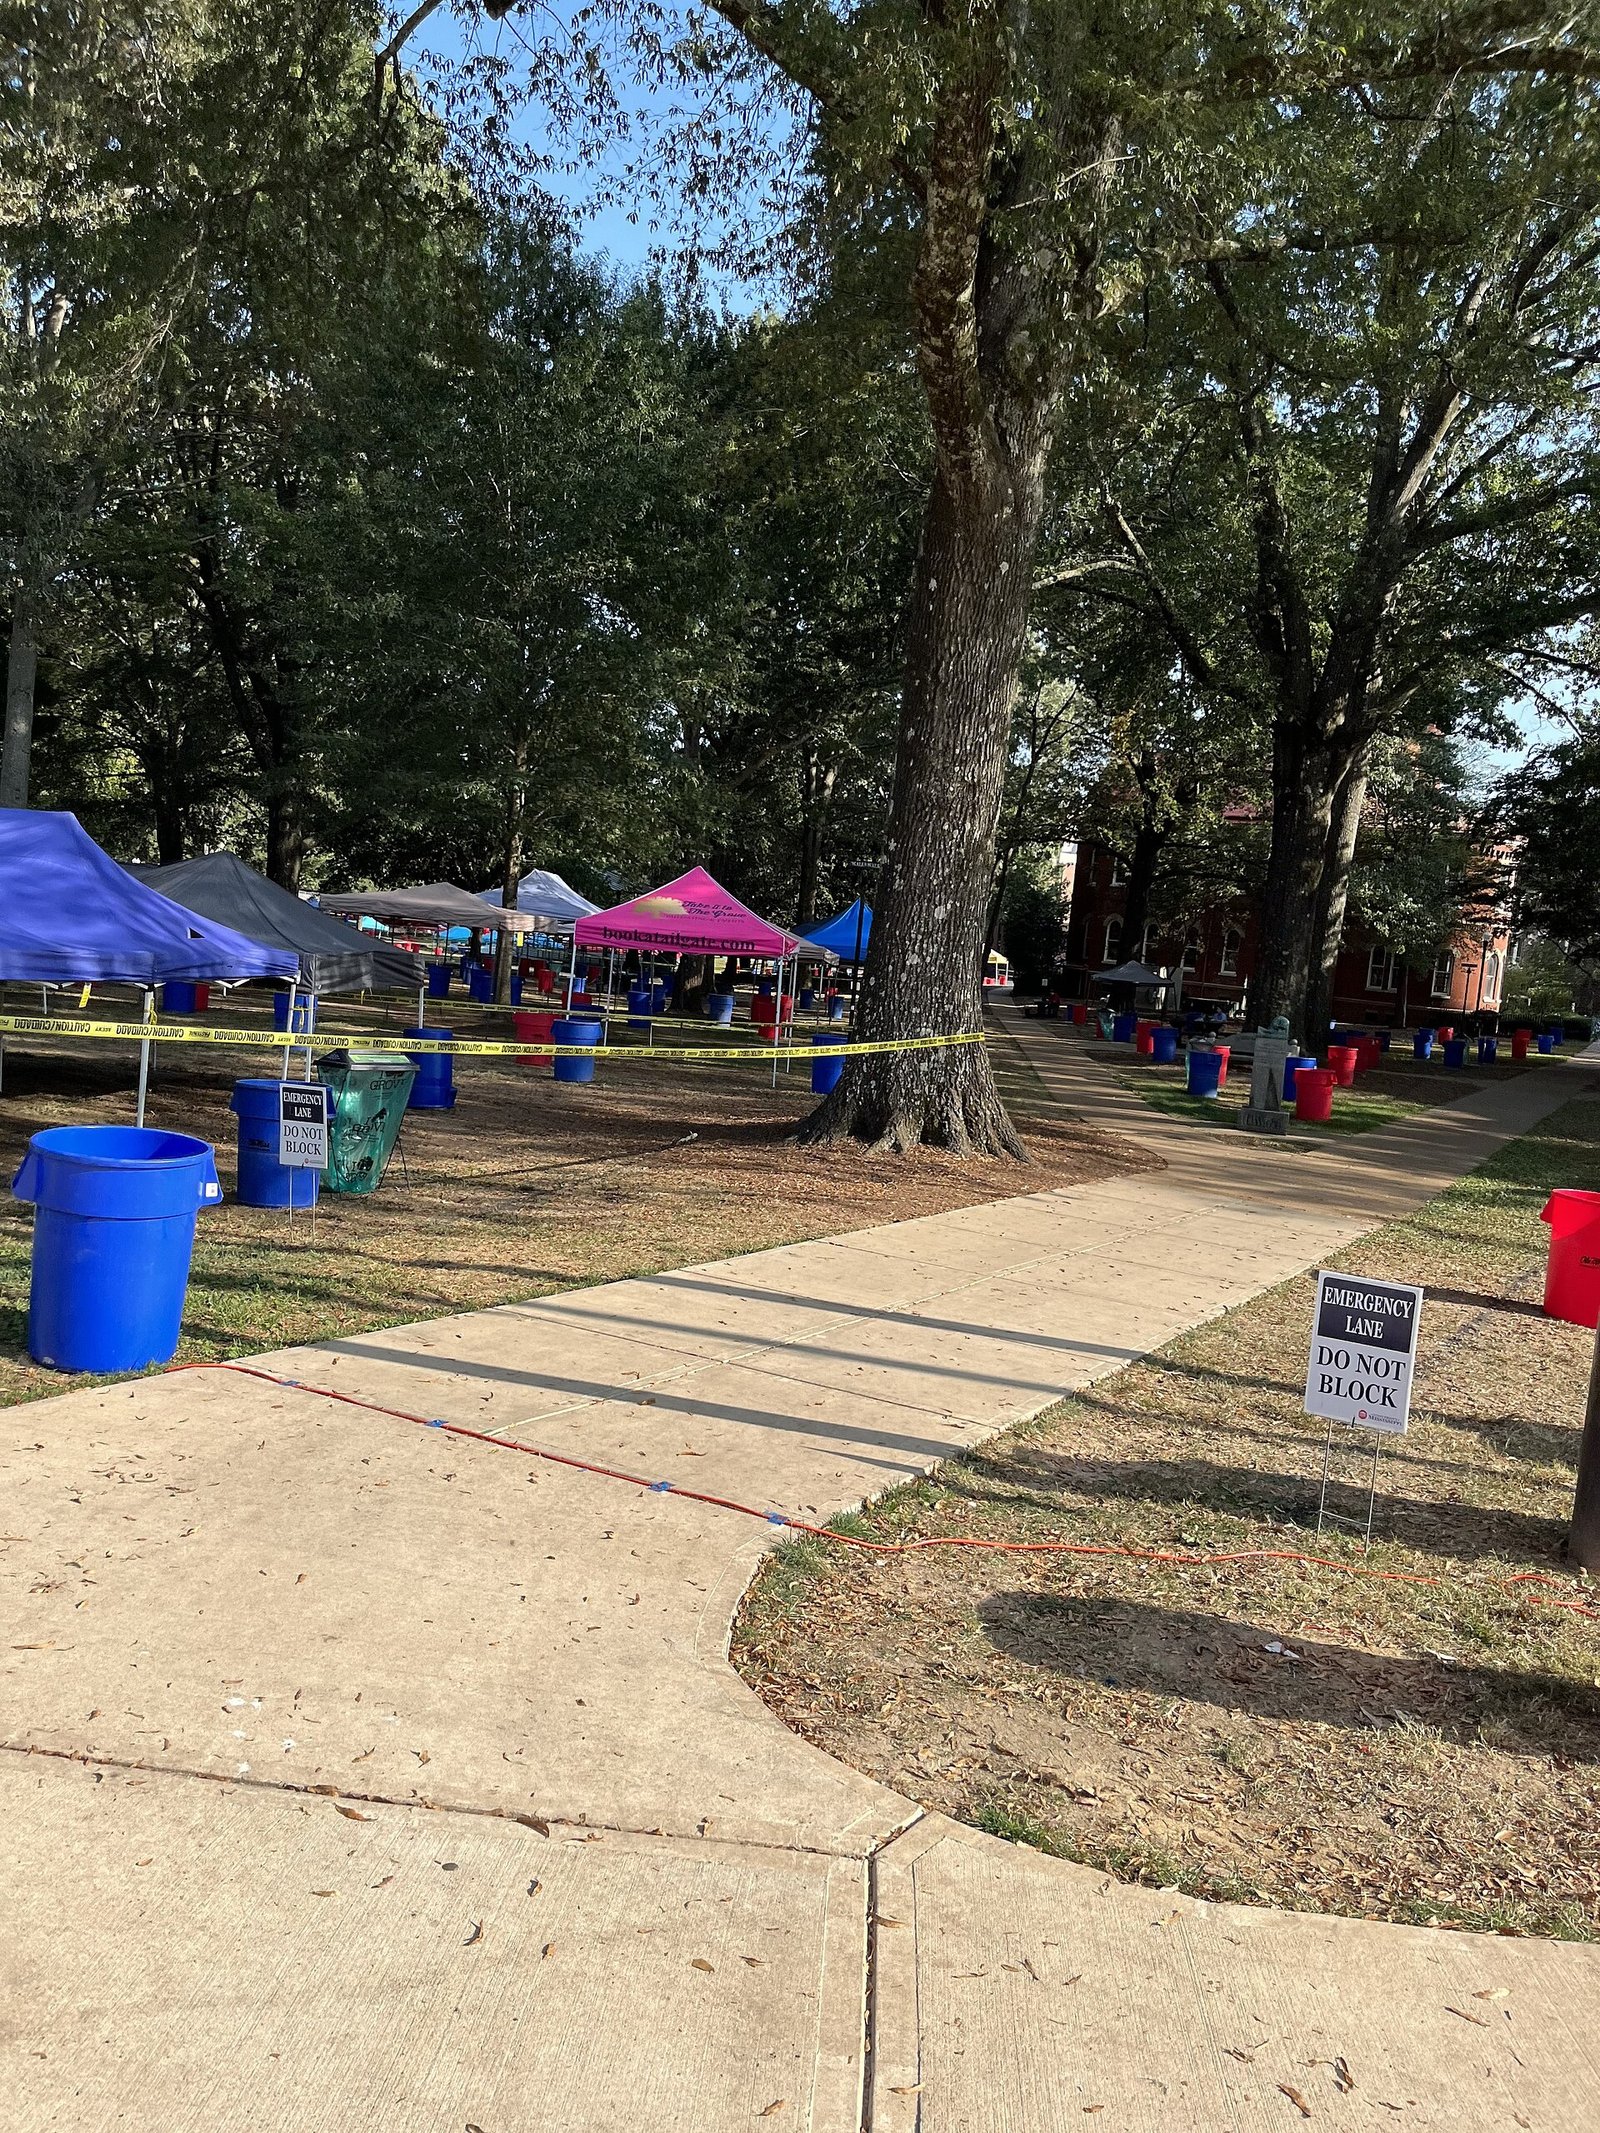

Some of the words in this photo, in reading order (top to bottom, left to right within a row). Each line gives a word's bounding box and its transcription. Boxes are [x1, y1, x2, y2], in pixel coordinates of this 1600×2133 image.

[711, 909, 747, 919] Grove
[602, 926, 756, 951] bookatailgate.com
[14, 1018, 91, 1033] CAUTION/CUIDADO
[116, 1024, 184, 1038] CAUTION/CUIDADO
[214, 1030, 275, 1043] CAUTION/CUIDADO
[294, 1034, 349, 1047] CAUTION/CUIDADO
[283, 1091, 323, 1106] EMERGENCY
[294, 1106, 312, 1118] LANE
[283, 1124, 299, 1138] DO
[301, 1126, 324, 1141] NOT
[286, 1140, 322, 1156] BLOCK
[1323, 1286, 1414, 1319] EMERGENCY
[1345, 1315, 1384, 1339] LANE
[1316, 1345, 1351, 1370] DO
[1355, 1353, 1407, 1382] NOT
[1318, 1373, 1398, 1409] BLOCK
